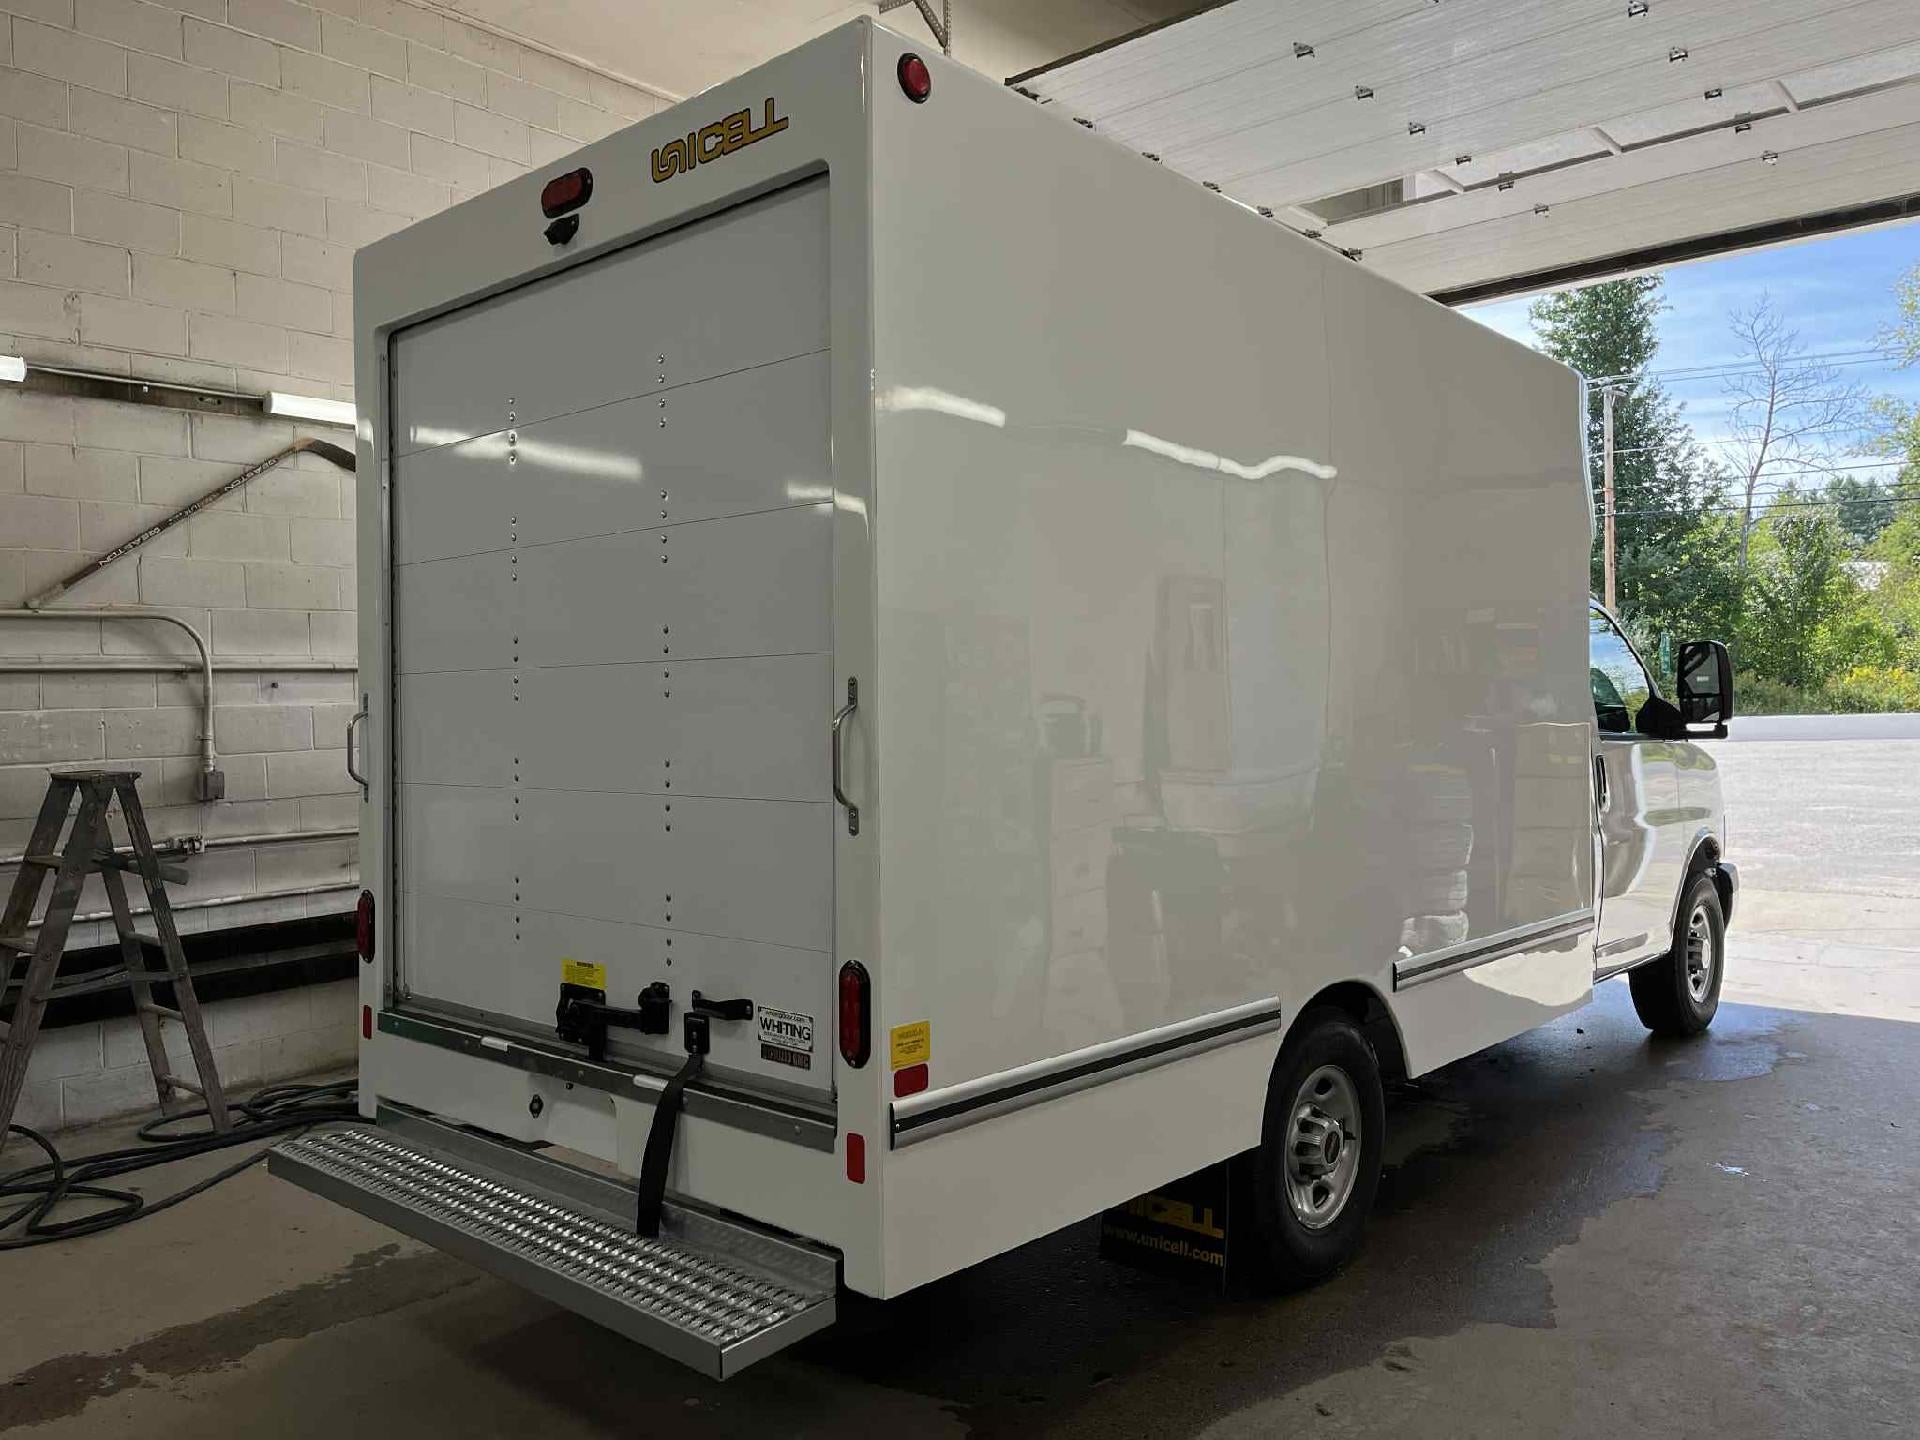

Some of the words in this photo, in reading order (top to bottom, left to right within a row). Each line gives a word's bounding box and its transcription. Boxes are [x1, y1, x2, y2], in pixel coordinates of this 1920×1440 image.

[652, 98, 789, 183] UNICELL
[760, 1017, 811, 1041] WHITING
[1103, 1224, 1224, 1268] www.unicell.com
